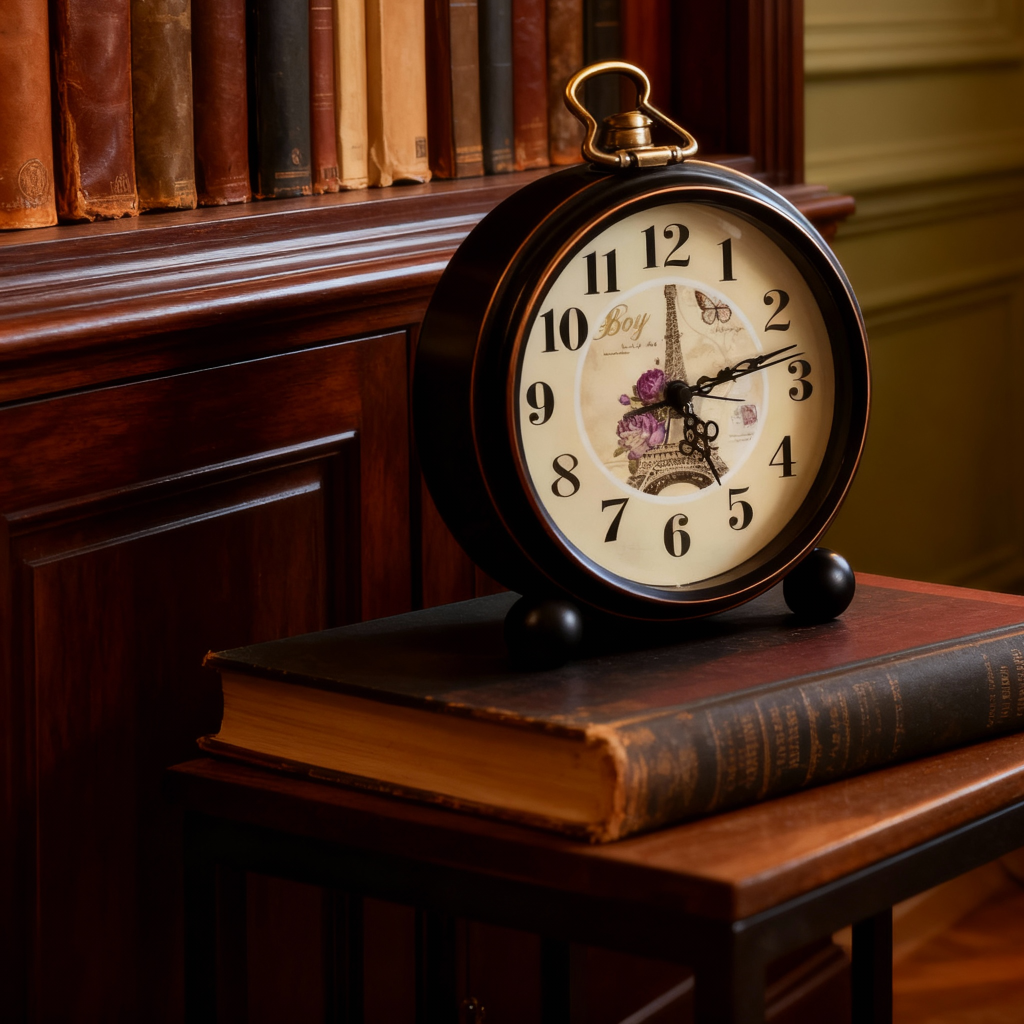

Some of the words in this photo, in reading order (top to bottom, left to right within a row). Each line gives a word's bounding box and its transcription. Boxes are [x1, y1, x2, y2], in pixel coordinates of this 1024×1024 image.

[641, 223, 690, 269] 12
[717, 238, 736, 281] 1
[583, 249, 620, 295] 11
[539, 307, 588, 352] 10
[594, 304, 650, 341] Boy
[764, 289, 791, 332] 2
[787, 359, 813, 401] 3
[526, 382, 554, 425] 9
[552, 454, 581, 497] 8
[769, 436, 797, 479] 4
[602, 498, 629, 542] 7
[728, 487, 753, 530] 5
[664, 514, 690, 557] 6
